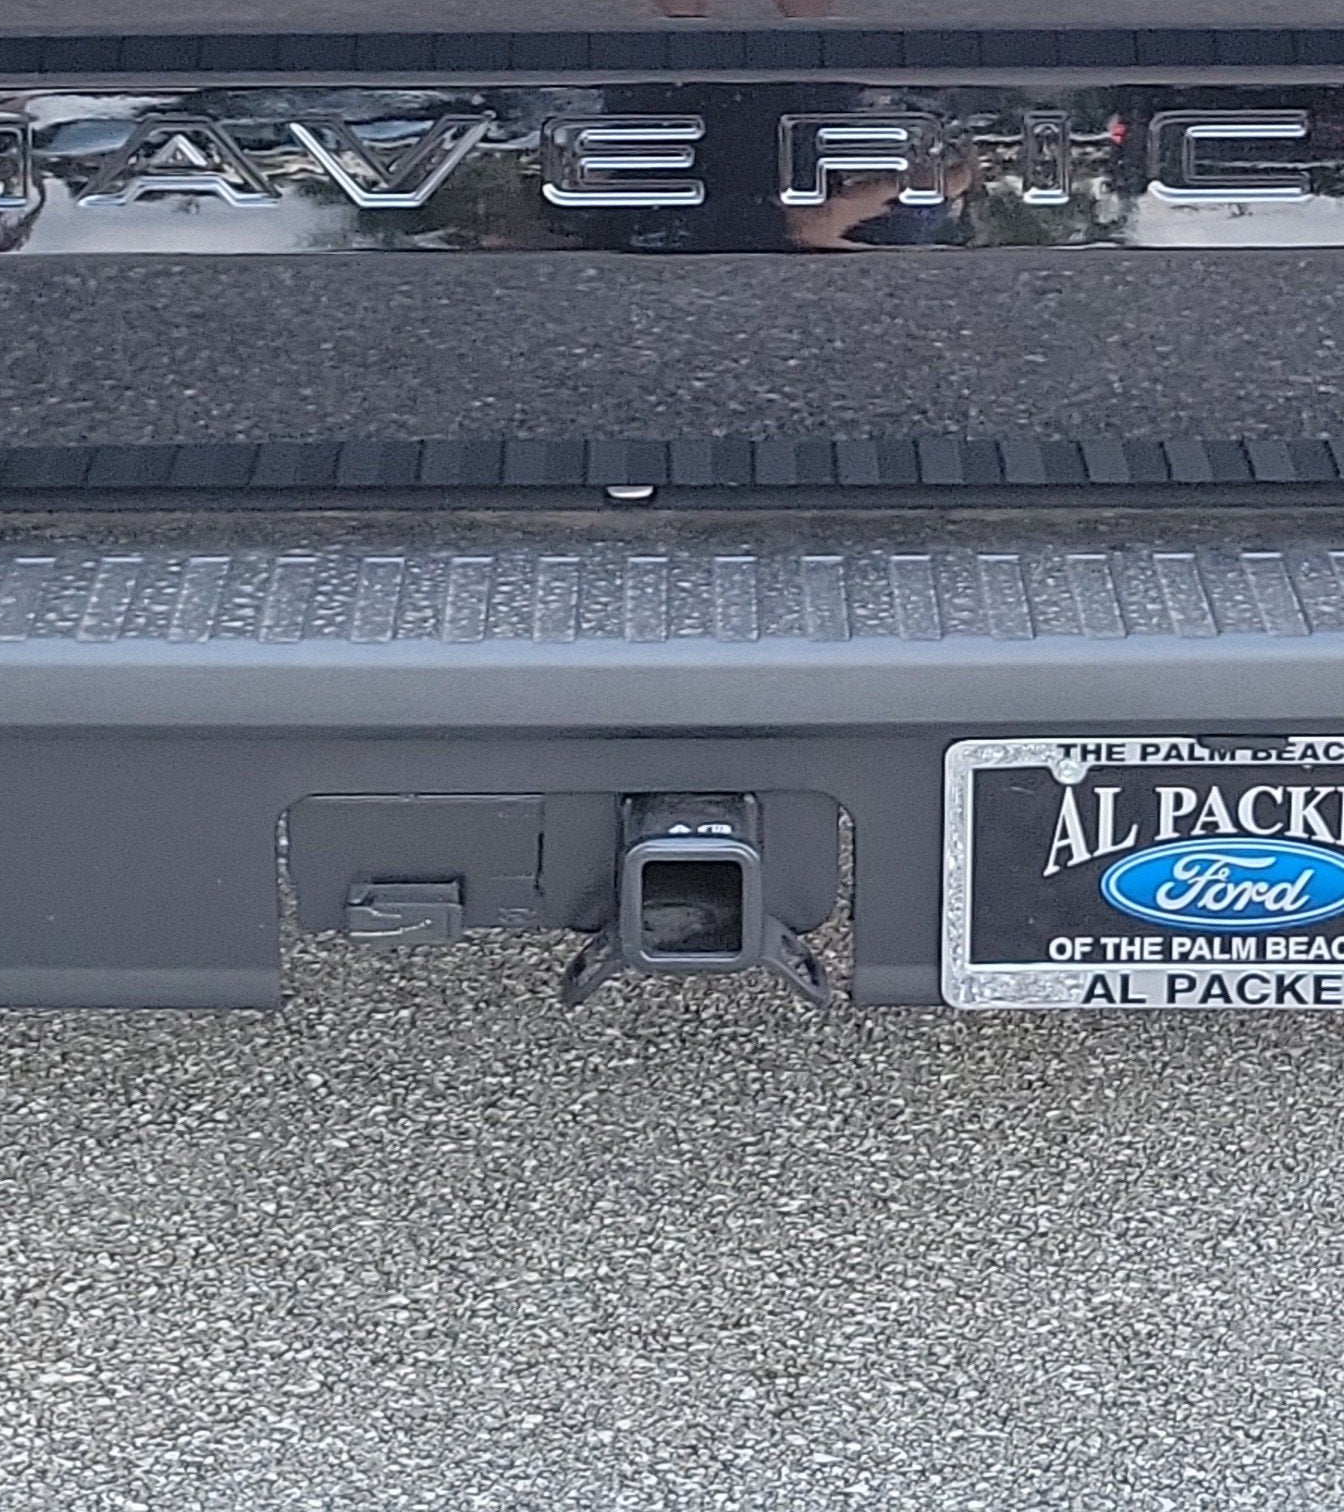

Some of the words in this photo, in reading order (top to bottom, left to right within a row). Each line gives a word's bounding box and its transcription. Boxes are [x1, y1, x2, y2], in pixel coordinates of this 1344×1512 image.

[1057, 742, 1126, 762] THE
[1043, 785, 1140, 876] AL
[1154, 852, 1311, 912] Ford
[1048, 936, 1095, 962] OF
[1100, 936, 1164, 962] THE
[1170, 936, 1256, 961] PALM
[1082, 974, 1148, 1006] AL
